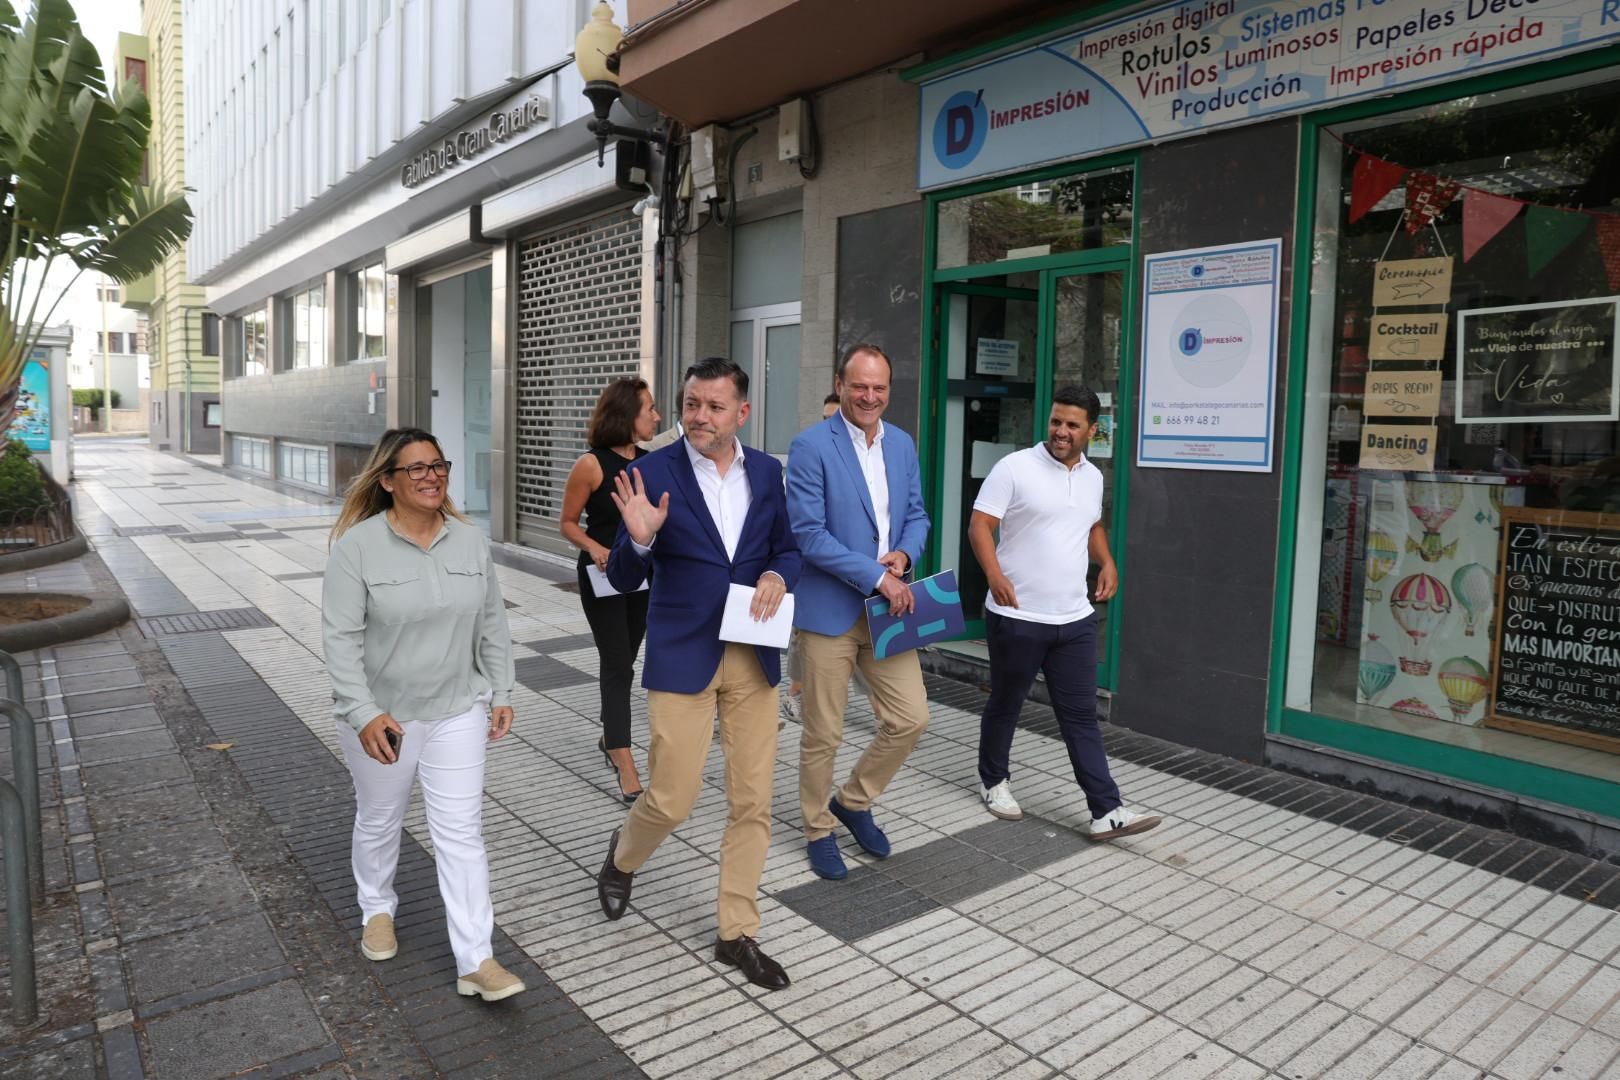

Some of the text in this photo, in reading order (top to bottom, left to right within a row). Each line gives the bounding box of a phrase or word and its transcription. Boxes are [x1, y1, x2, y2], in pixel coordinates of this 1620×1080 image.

[1241, 0, 1346, 42] Sistemas
[1467, 0, 1542, 20] Dec
[1079, 0, 1235, 60] Impresión digital
[1356, 8, 1455, 50] Papeles
[1122, 33, 1212, 76] Rotulos
[1225, 28, 1340, 71] Luminosos
[1330, 16, 1544, 86] Impresión rápida
[1137, 61, 1219, 99] Vinilos
[1172, 73, 1302, 120] Producción
[401, 95, 543, 188] Cabildo de Gran Canaria
[1377, 322, 1439, 337] Cocktail
[1487, 340, 1581, 353] Viaje de nuestra
[1495, 353, 1571, 402] Vida
[1166, 415, 1220, 425] 666 99 48 21
[1367, 433, 1429, 456] Dancing
[1510, 526, 1547, 551] En
[1556, 536, 1604, 555] este
[1510, 552, 1552, 575] TAN
[1508, 595, 1538, 613] QUE
[1539, 581, 1606, 599] queremos
[1506, 613, 1548, 632] Con
[1556, 617, 1575, 637] la
[1536, 676, 1553, 690] NO
[1557, 680, 1590, 697] FALTE
[1595, 686, 1610, 700] DE
